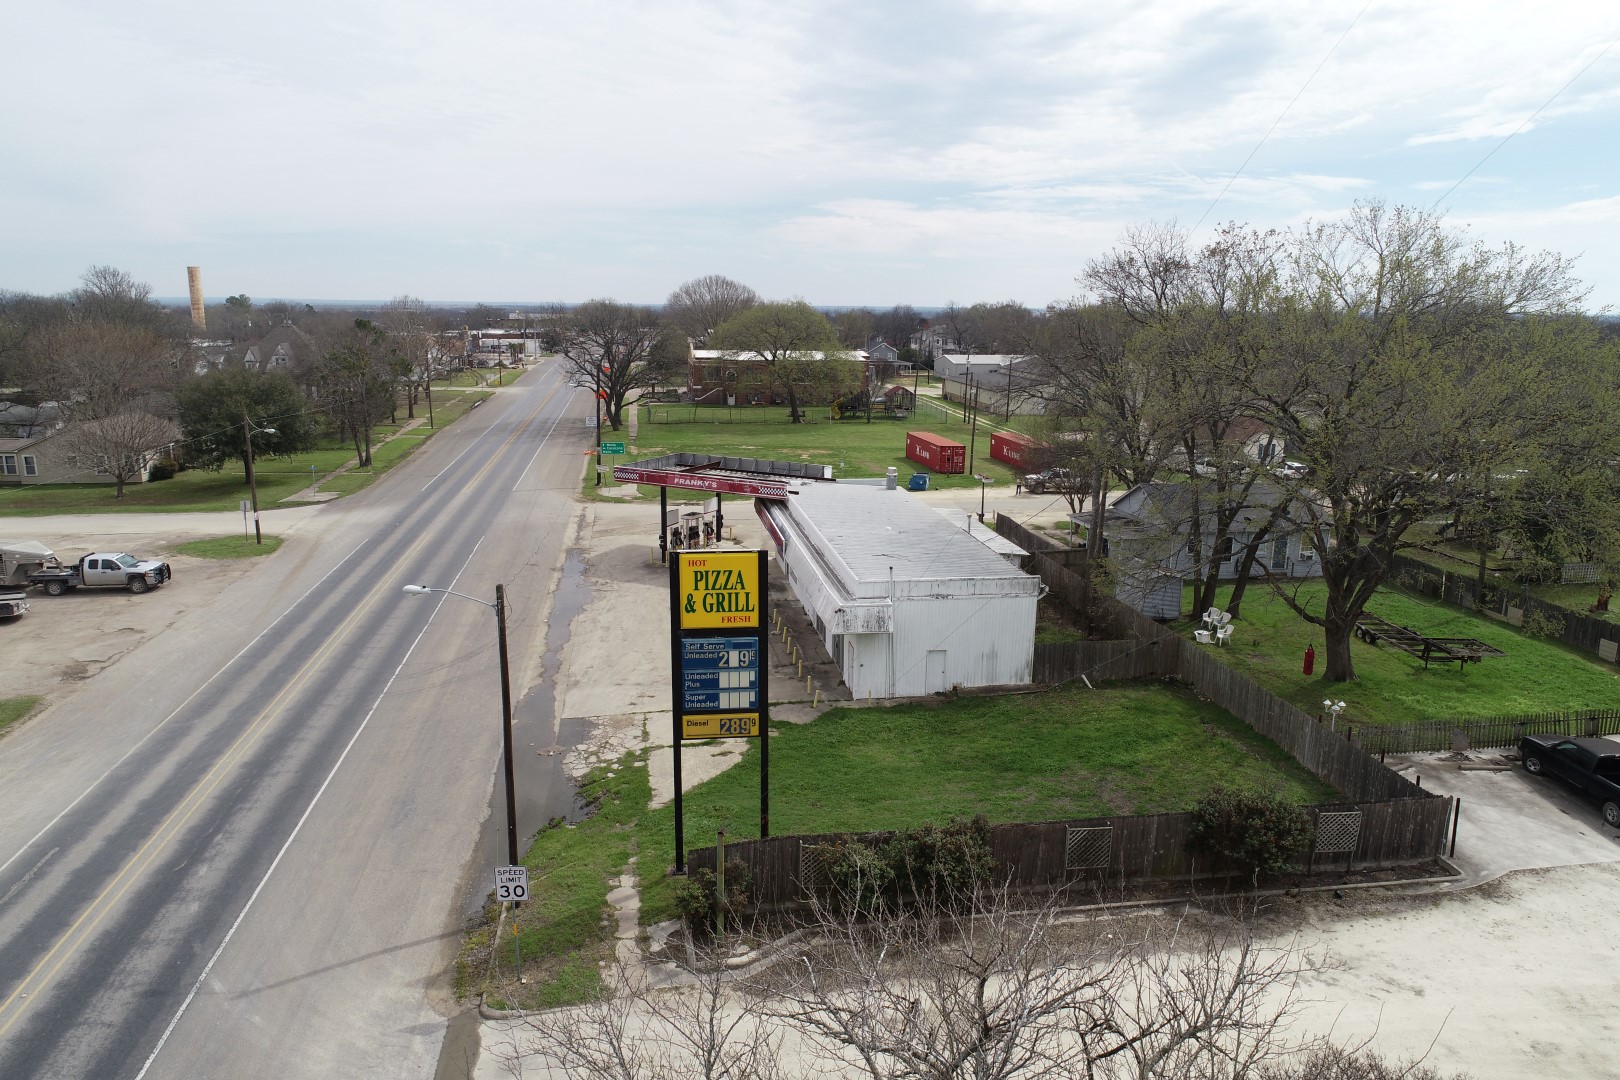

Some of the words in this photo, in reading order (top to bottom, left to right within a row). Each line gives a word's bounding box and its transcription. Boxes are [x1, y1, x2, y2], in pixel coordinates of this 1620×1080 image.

[674, 477, 718, 488] FRANKY'S
[688, 559, 707, 567] HOT
[693, 569, 746, 591] PIZZA
[684, 592, 697, 614] &
[702, 591, 756, 614] GRILL
[721, 615, 751, 624] FRESH
[685, 642, 700, 651] Self
[703, 642, 725, 650] Serve
[684, 651, 718, 659] Unleaded
[684, 672, 719, 680] Unleaded
[685, 680, 700, 688] Plus
[685, 693, 706, 702] Super
[686, 719, 709, 727] Diesel
[500, 884, 526, 898] 30
